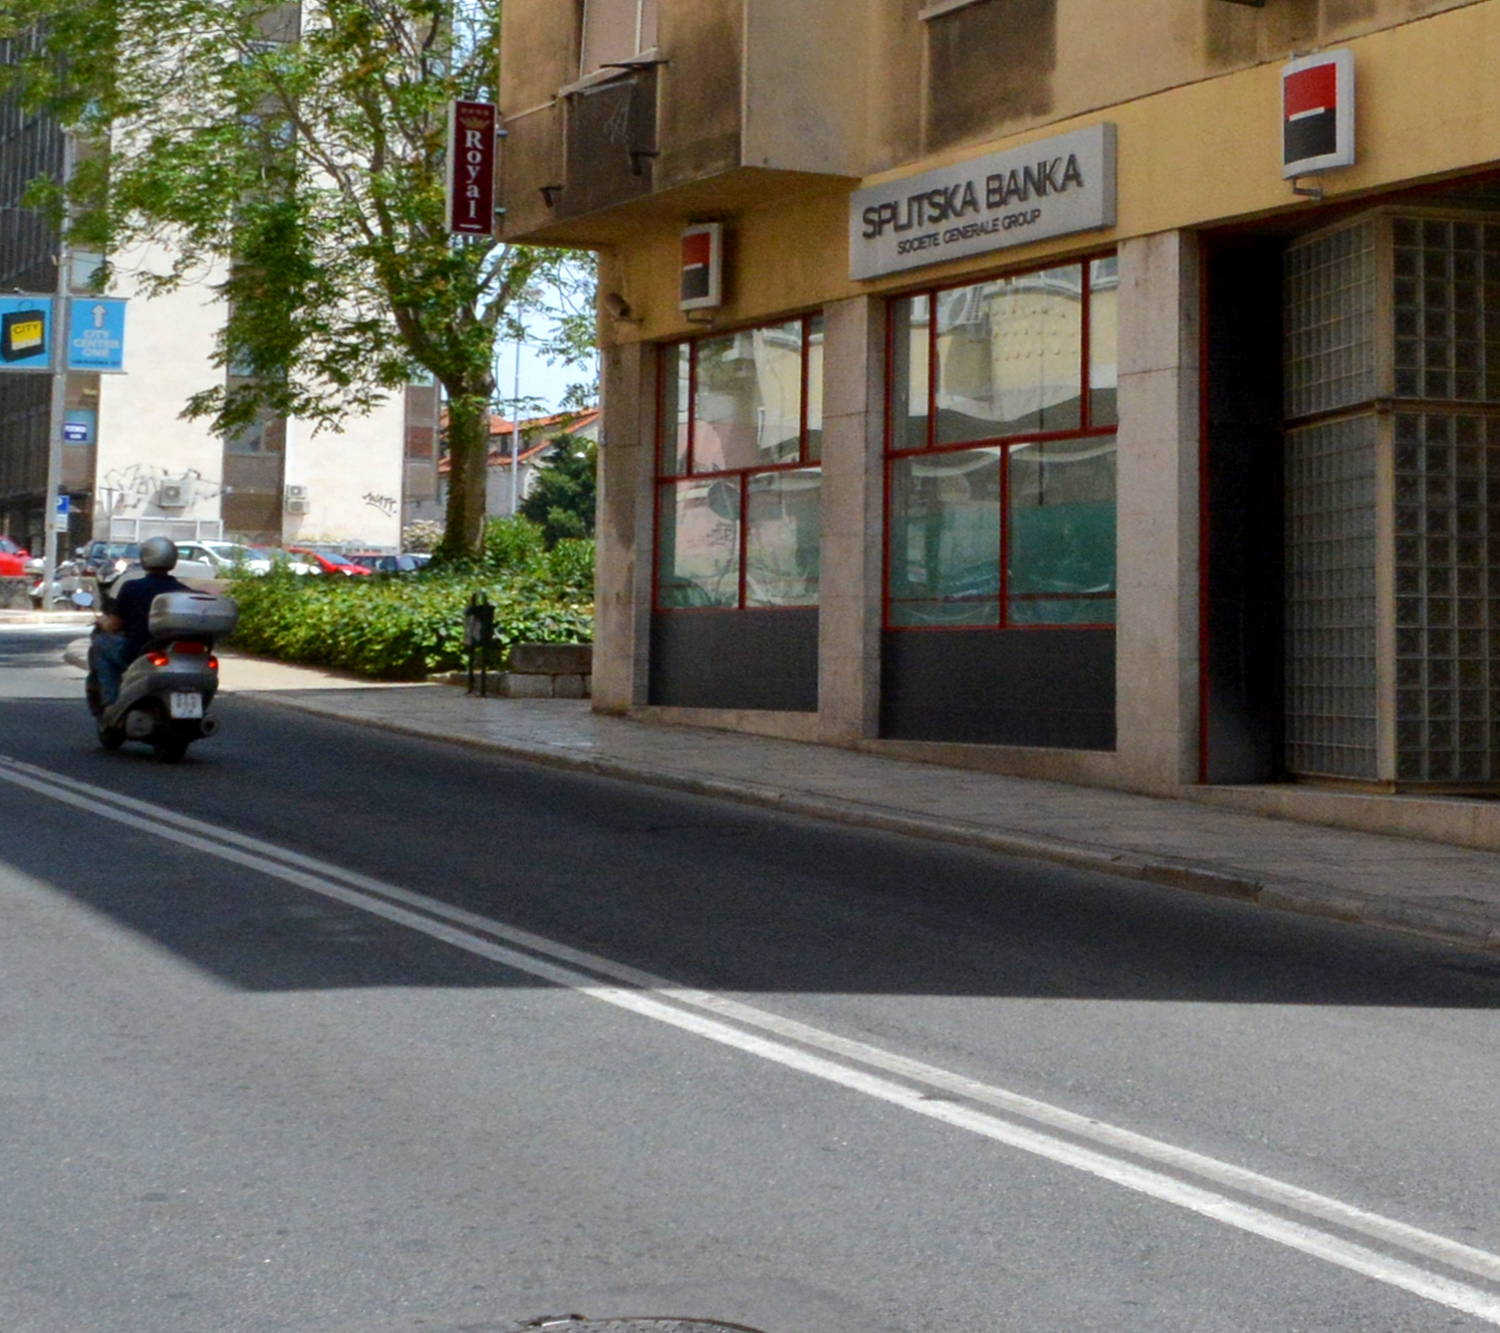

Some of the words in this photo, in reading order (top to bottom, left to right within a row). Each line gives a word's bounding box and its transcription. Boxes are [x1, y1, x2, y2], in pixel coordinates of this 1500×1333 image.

[464, 129, 484, 219] Royal
[862, 180, 980, 240] SPLITSKA
[986, 153, 1085, 210] BANKA
[897, 232, 940, 255] SOCIETE
[943, 218, 1000, 245] GENERALE
[1002, 209, 1042, 231] GROUP
